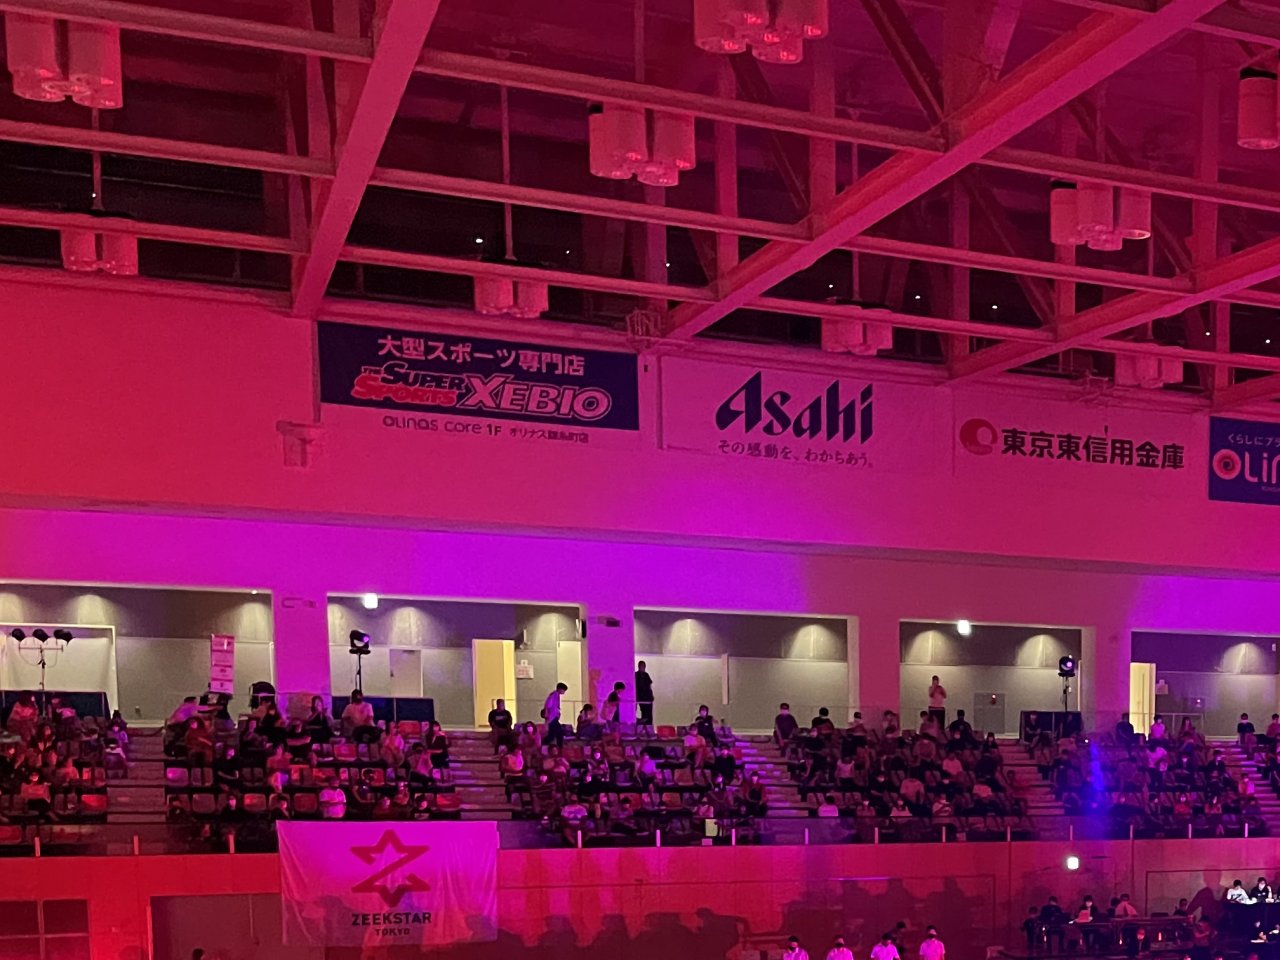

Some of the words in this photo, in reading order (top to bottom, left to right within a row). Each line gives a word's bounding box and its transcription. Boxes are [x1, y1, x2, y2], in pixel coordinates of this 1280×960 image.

[377, 335, 585, 377] 大型スポーツ専門店
[380, 361, 466, 392] SUPER
[351, 374, 458, 406] SPORTS
[457, 373, 612, 421] XEBIO
[715, 370, 873, 445] Asahi
[486, 423, 502, 436] 1F
[1001, 427, 1185, 470] 東京東信用金庫
[351, 911, 432, 926] ZEEKSTAR
[374, 927, 411, 937] TOKYO
